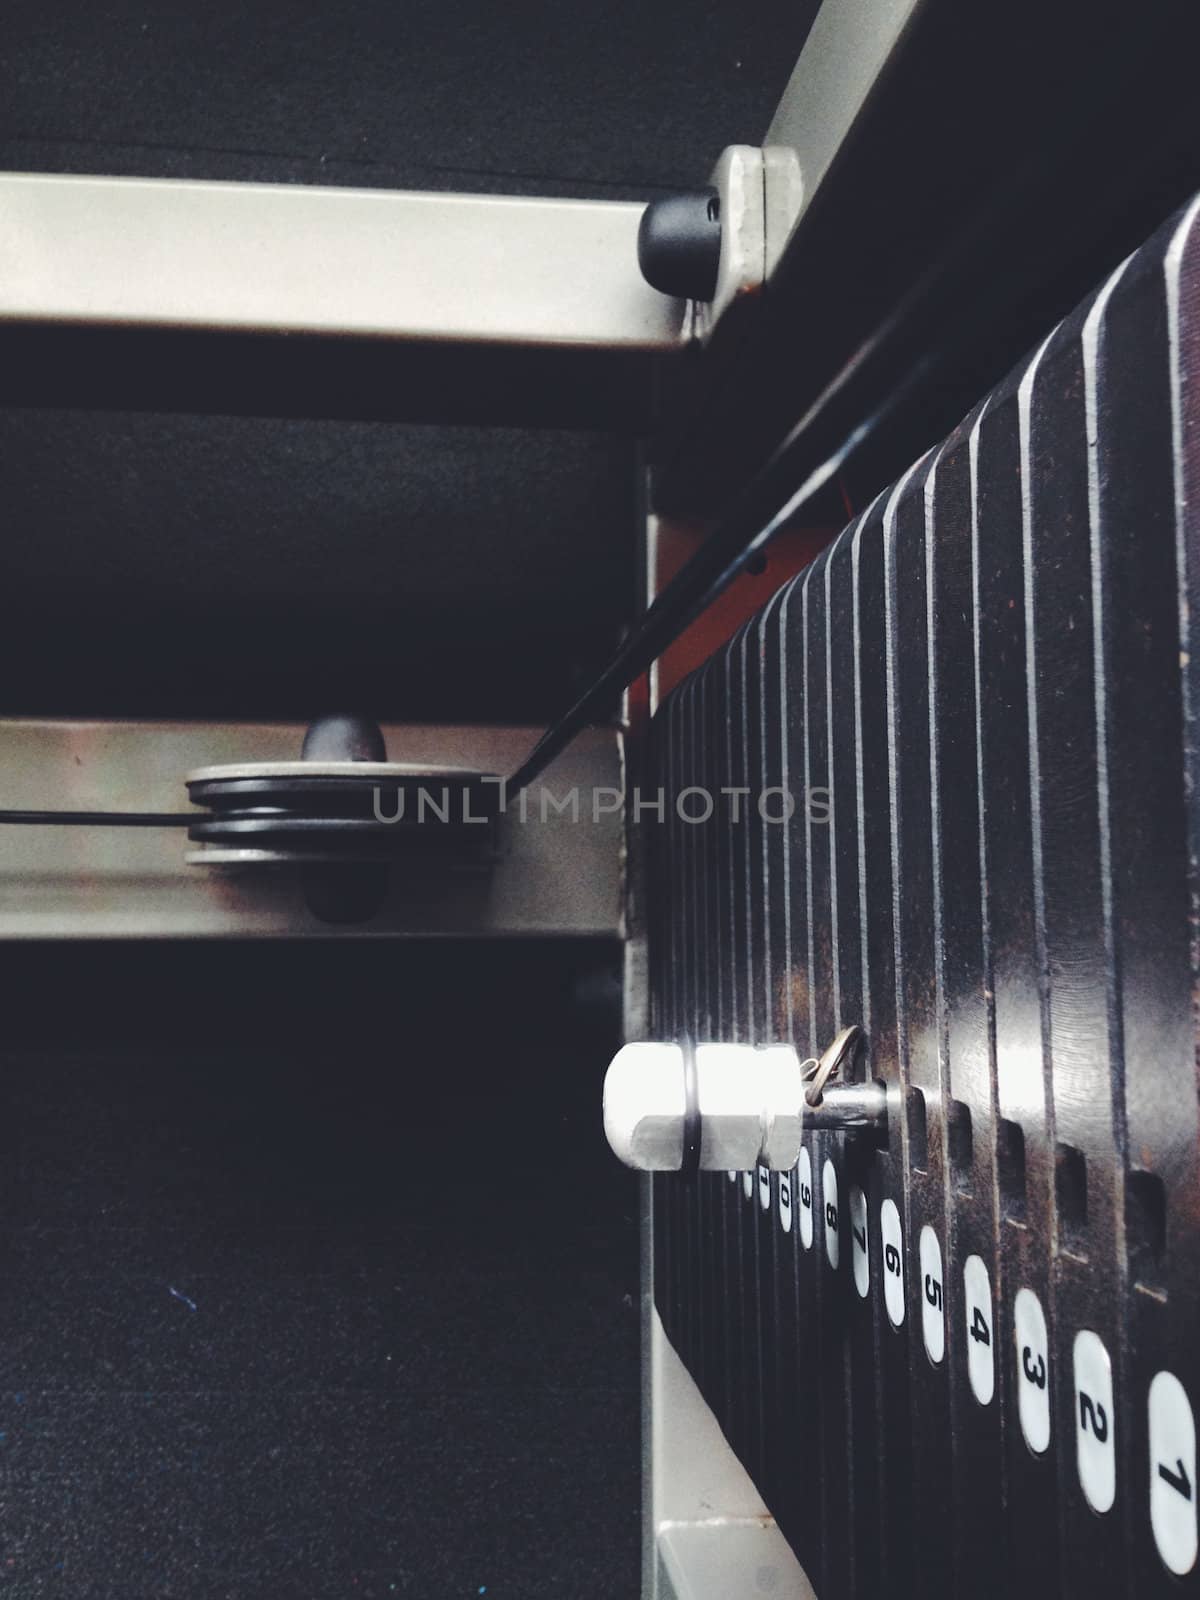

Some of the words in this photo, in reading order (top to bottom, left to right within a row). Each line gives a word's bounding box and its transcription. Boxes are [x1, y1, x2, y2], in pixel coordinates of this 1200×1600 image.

[801, 1184, 810, 1208] 9
[826, 1202, 838, 1232] 8
[853, 1224, 866, 1253] 7
[885, 1243, 901, 1278] 6
[925, 1273, 942, 1313] 5
[969, 1307, 991, 1348] 4
[1023, 1346, 1046, 1390] 3
[1079, 1390, 1108, 1443] 2
[1158, 1458, 1192, 1502] 1
